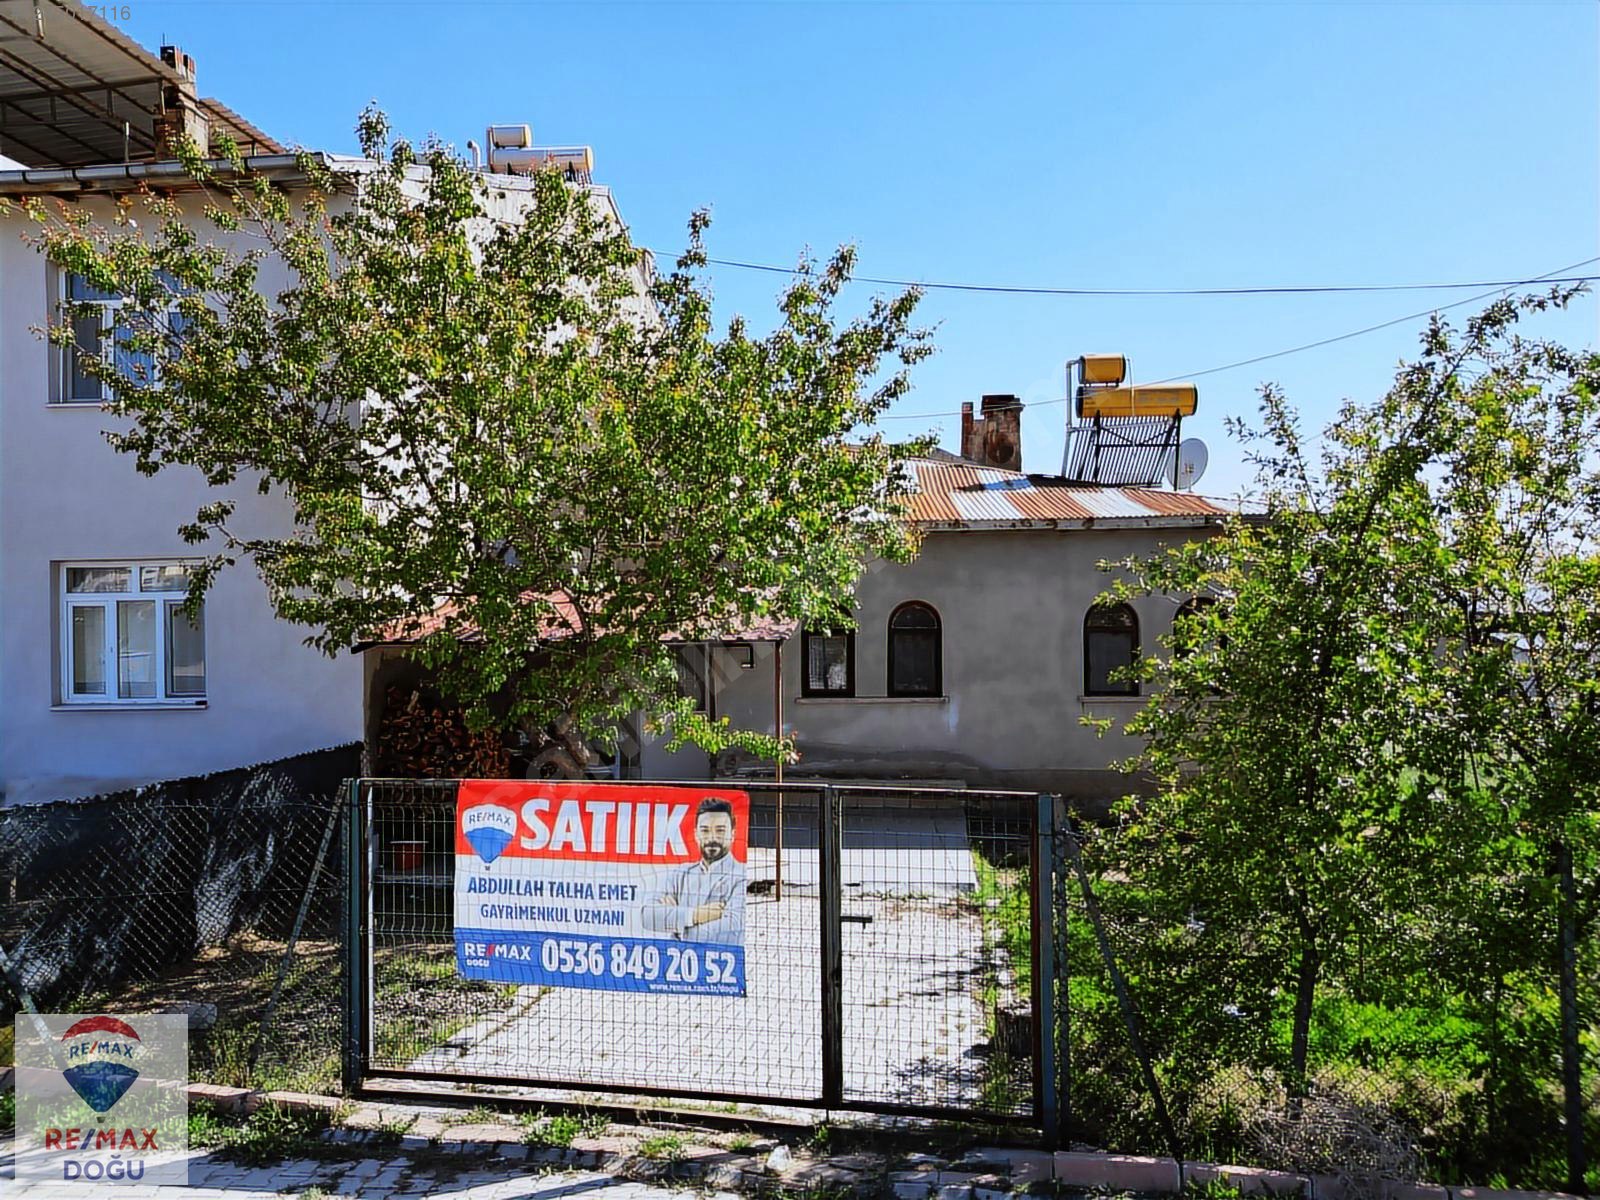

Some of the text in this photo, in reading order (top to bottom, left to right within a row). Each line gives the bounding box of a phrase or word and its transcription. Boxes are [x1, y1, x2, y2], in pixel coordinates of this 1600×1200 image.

[468, 811, 512, 826] RE/MAX
[467, 876, 638, 902] ABDULLAH TALHA EMET
[480, 903, 625, 926] GAYRİMENKUL UZMANI
[464, 942, 532, 961] RE/MAX
[541, 938, 738, 984] 0536 849 20 52
